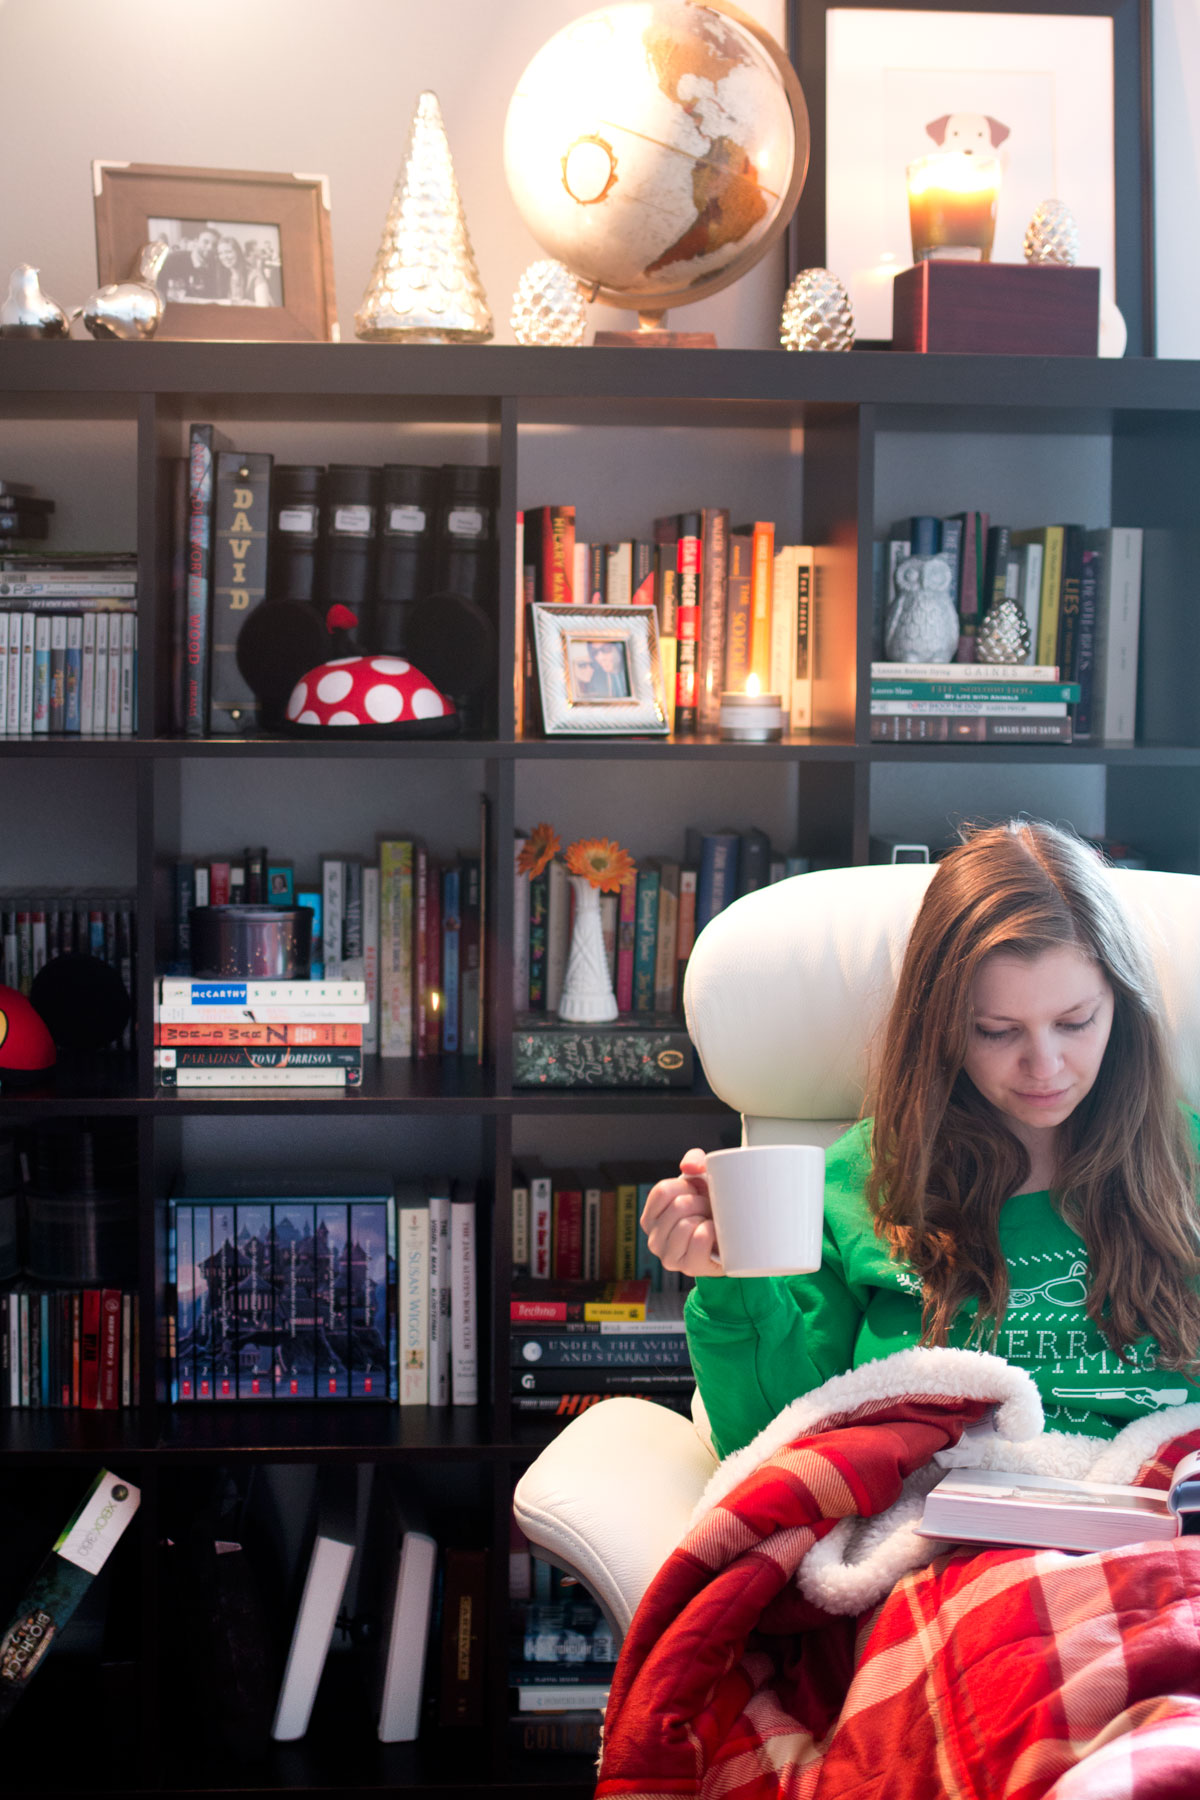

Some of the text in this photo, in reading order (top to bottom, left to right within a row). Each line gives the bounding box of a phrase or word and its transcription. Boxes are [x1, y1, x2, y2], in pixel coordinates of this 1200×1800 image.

[190, 487, 203, 598] GOLDSWORTHY
[229, 488, 254, 610] DAVID
[553, 517, 565, 567] HILARY
[682, 536, 697, 606] LISA UNGER
[1063, 579, 1080, 615] LIES
[1081, 579, 1097, 625] DEATH
[188, 614, 200, 665] WOOD
[681, 639, 695, 662] THE
[964, 666, 1019, 677] GAINES
[990, 694, 1019, 702] ANIMALS
[192, 990, 247, 999] McCARTHY
[254, 989, 359, 997] SUTTREE
[167, 1025, 288, 1044] WORLD WAR Z
[182, 1053, 242, 1065] PARADISE
[251, 1053, 332, 1065] TONI MORRISON
[624, 1193, 634, 1211] THE
[440, 1219, 448, 1237] THE
[536, 1211, 548, 1227] The
[430, 1255, 439, 1276] MAN
[462, 1222, 471, 1350] THE JANE AUSTEN BOOK CLUB
[408, 1251, 422, 1347] SUSAN WIGGS
[440, 1288, 448, 1317] CHUCK
[518, 1303, 557, 1318] Techno
[548, 1341, 688, 1351] UNDER THE WIDE
[560, 1352, 680, 1363] AND STARRY SKY
[77, 1500, 118, 1558] XBOX 360
[4, 1613, 50, 1680] BIOSHOCK
